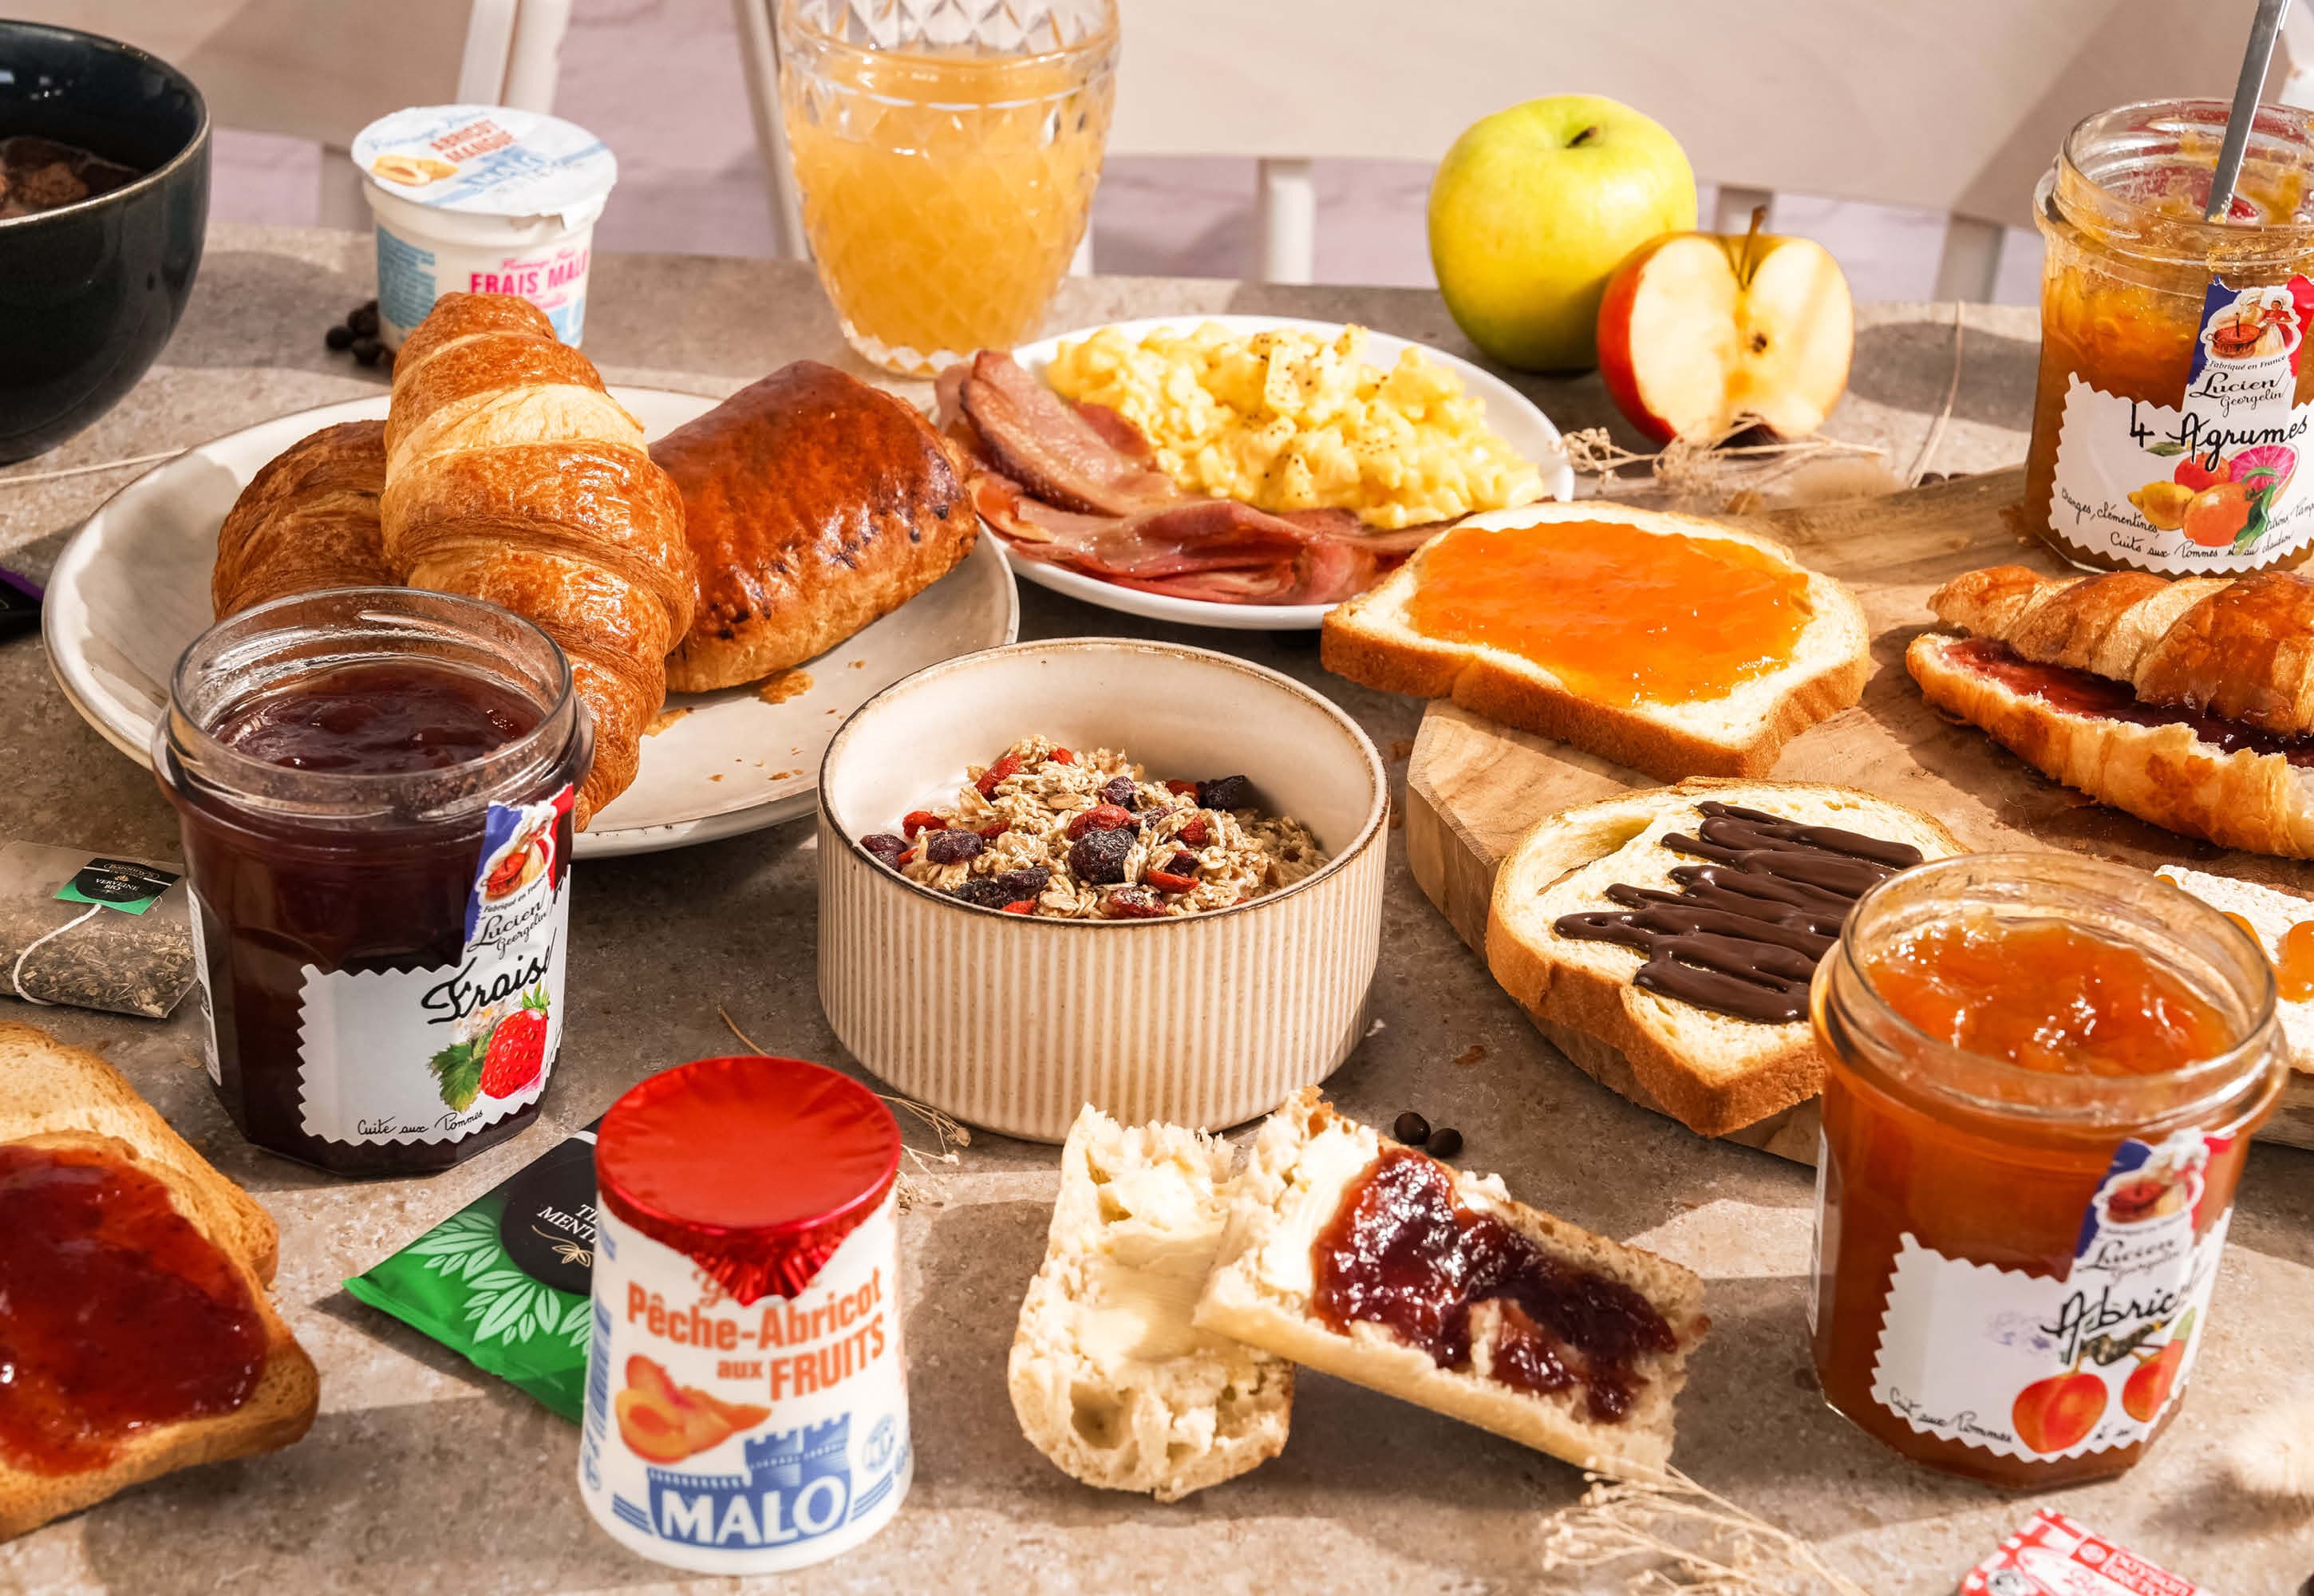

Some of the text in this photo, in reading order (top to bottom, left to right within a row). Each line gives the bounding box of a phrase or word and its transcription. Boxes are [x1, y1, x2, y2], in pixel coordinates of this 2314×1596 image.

[469, 271, 539, 295] FRAIS
[2260, 356, 2286, 368] France
[2189, 369, 2284, 399] Lucien
[2220, 385, 2287, 418] Georgelin
[2130, 403, 2308, 472] 4 Agrumes
[2110, 531, 2145, 552] Cuits
[2175, 539, 2218, 558] Pommes
[96, 878, 140, 891] VERVEINE
[518, 892, 527, 903] en
[466, 888, 547, 953] Lucien
[496, 909, 551, 960] Georgelin
[357, 1112, 484, 1136] Cuite aux Pommes
[536, 1206, 598, 1244] MENT
[627, 1266, 882, 1352] Pêche-Abricot
[717, 1313, 886, 1402] aux FRUITS
[660, 1475, 847, 1547] MALO
